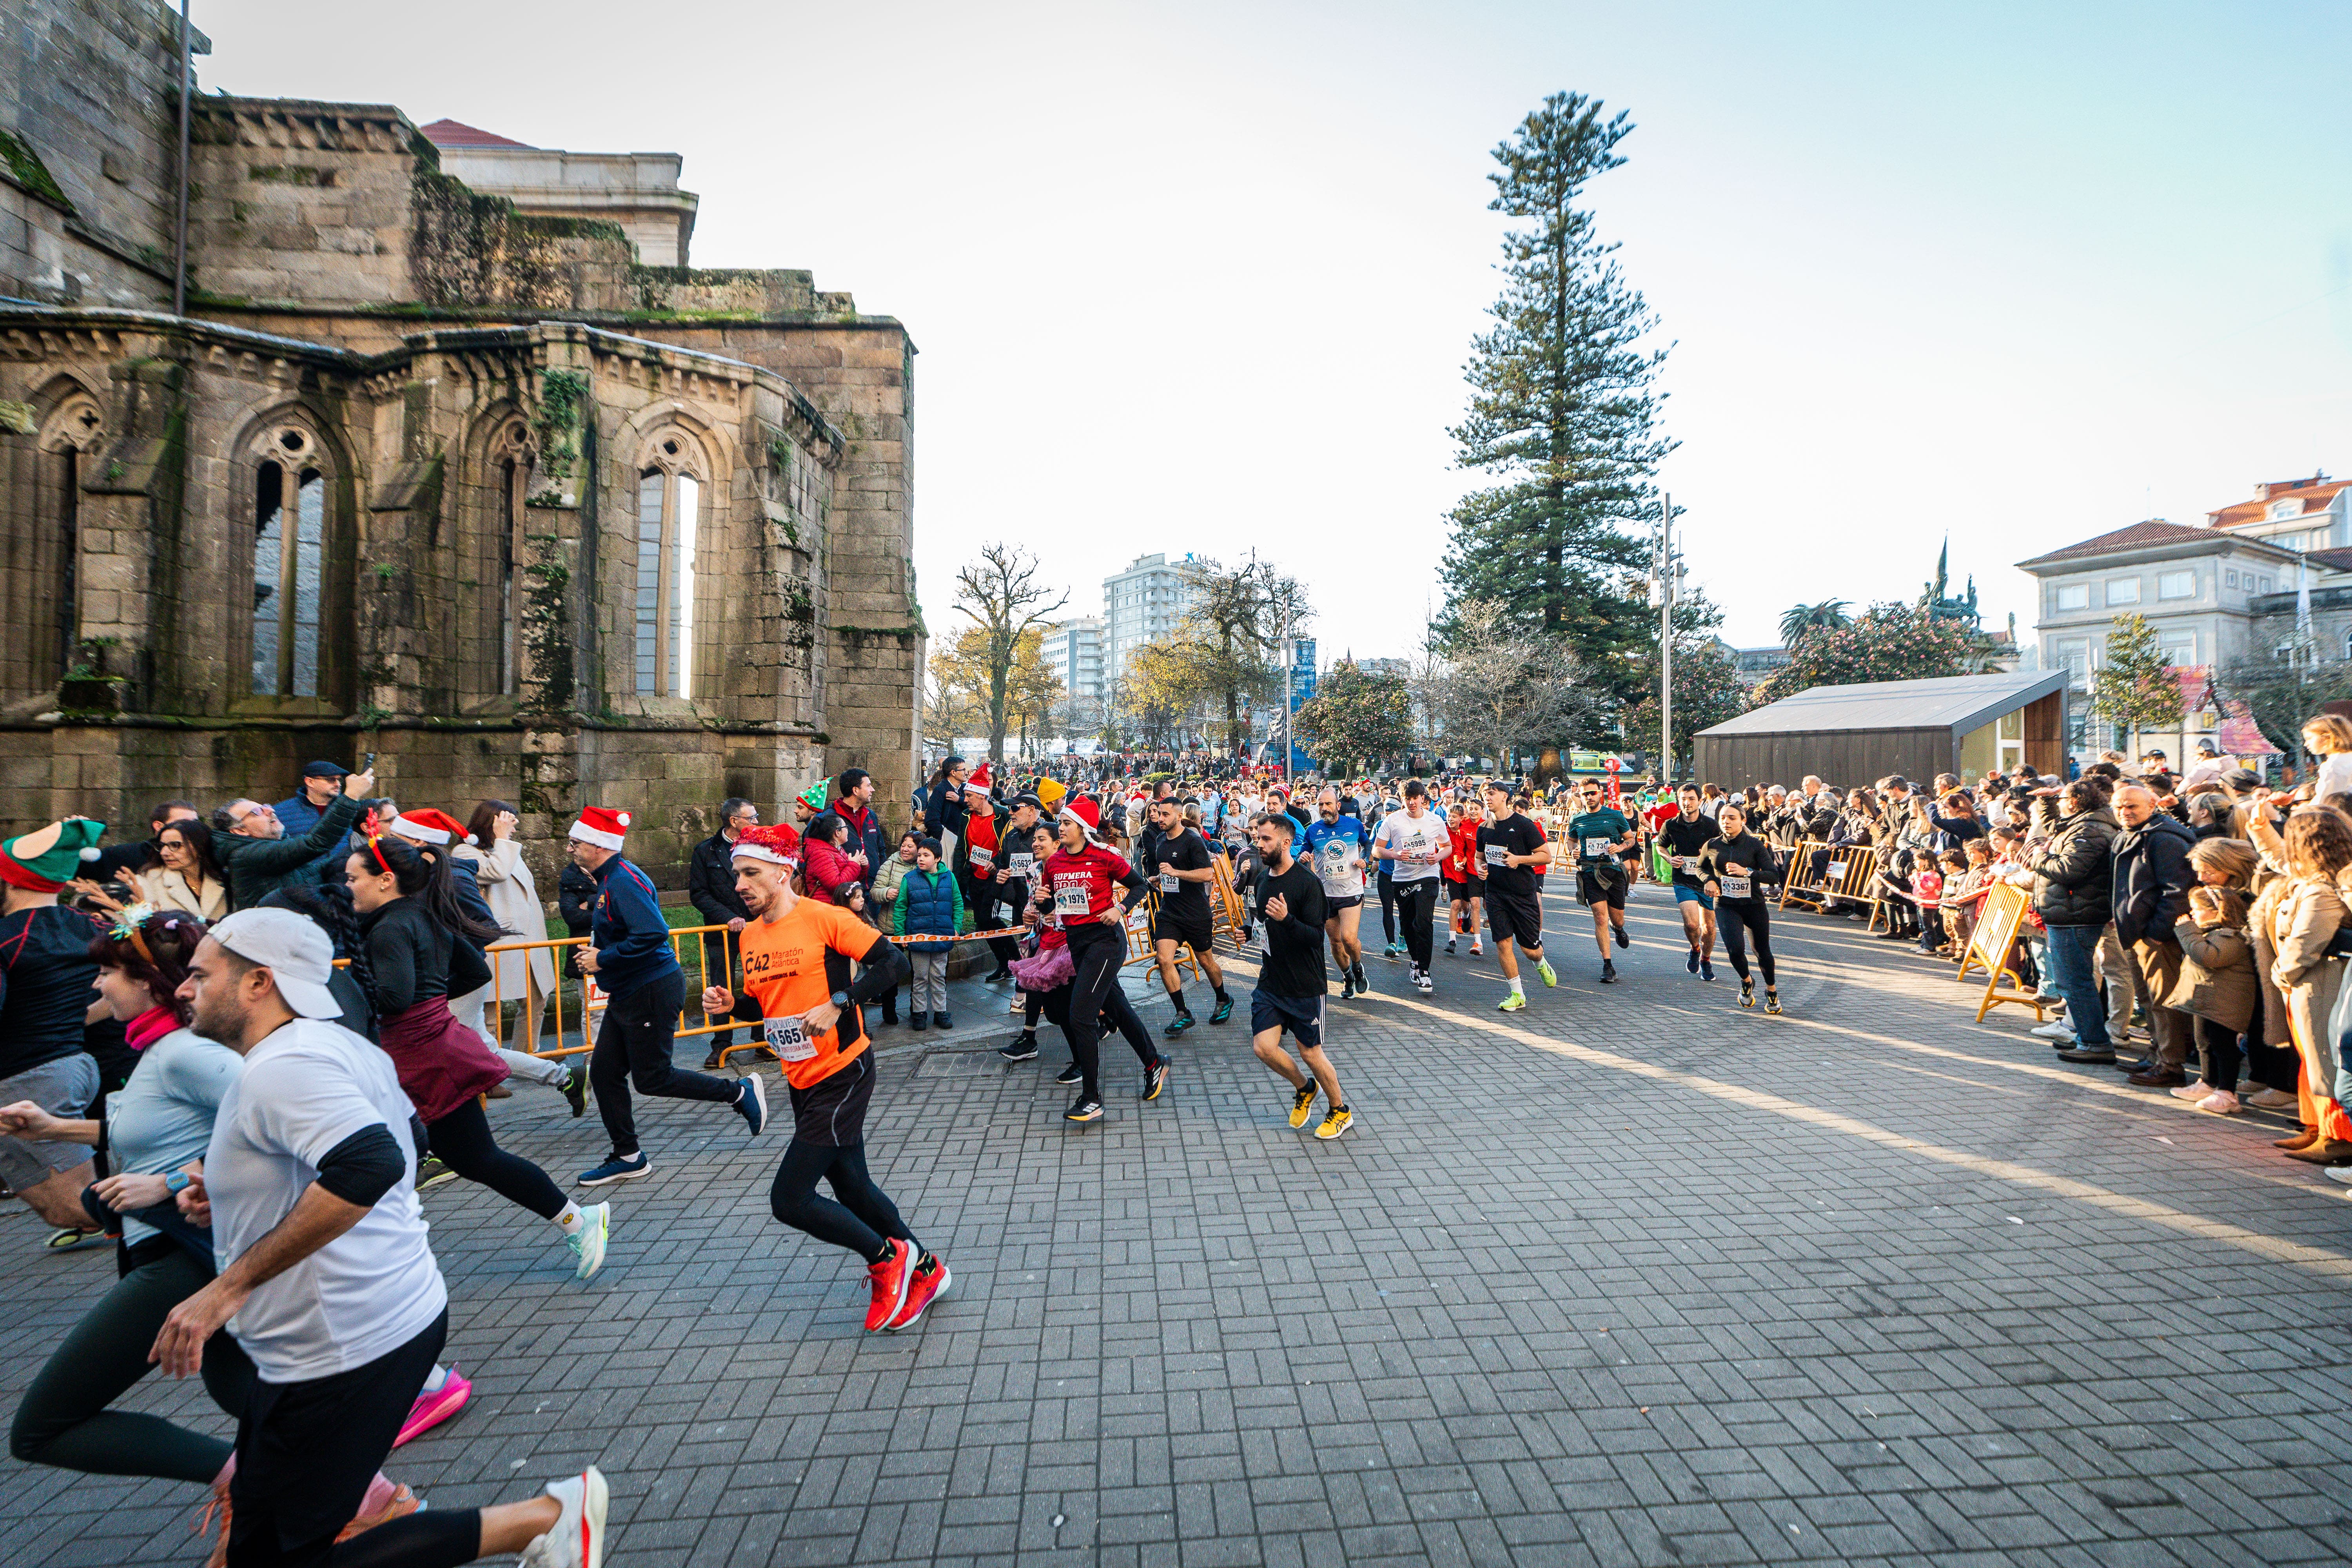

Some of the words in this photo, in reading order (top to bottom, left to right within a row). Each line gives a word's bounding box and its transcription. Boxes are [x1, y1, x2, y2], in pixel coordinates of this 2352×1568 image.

[1196, 554, 1222, 568] Adeslas
[1410, 839, 1426, 848] 5995
[977, 852, 991, 861] 4955
[1017, 859, 1031, 868] 5632
[1054, 871, 1093, 880] SUPMERA
[1068, 894, 1085, 904] 1979
[772, 947, 803, 960] Maratón
[771, 958, 799, 968] Atlántica
